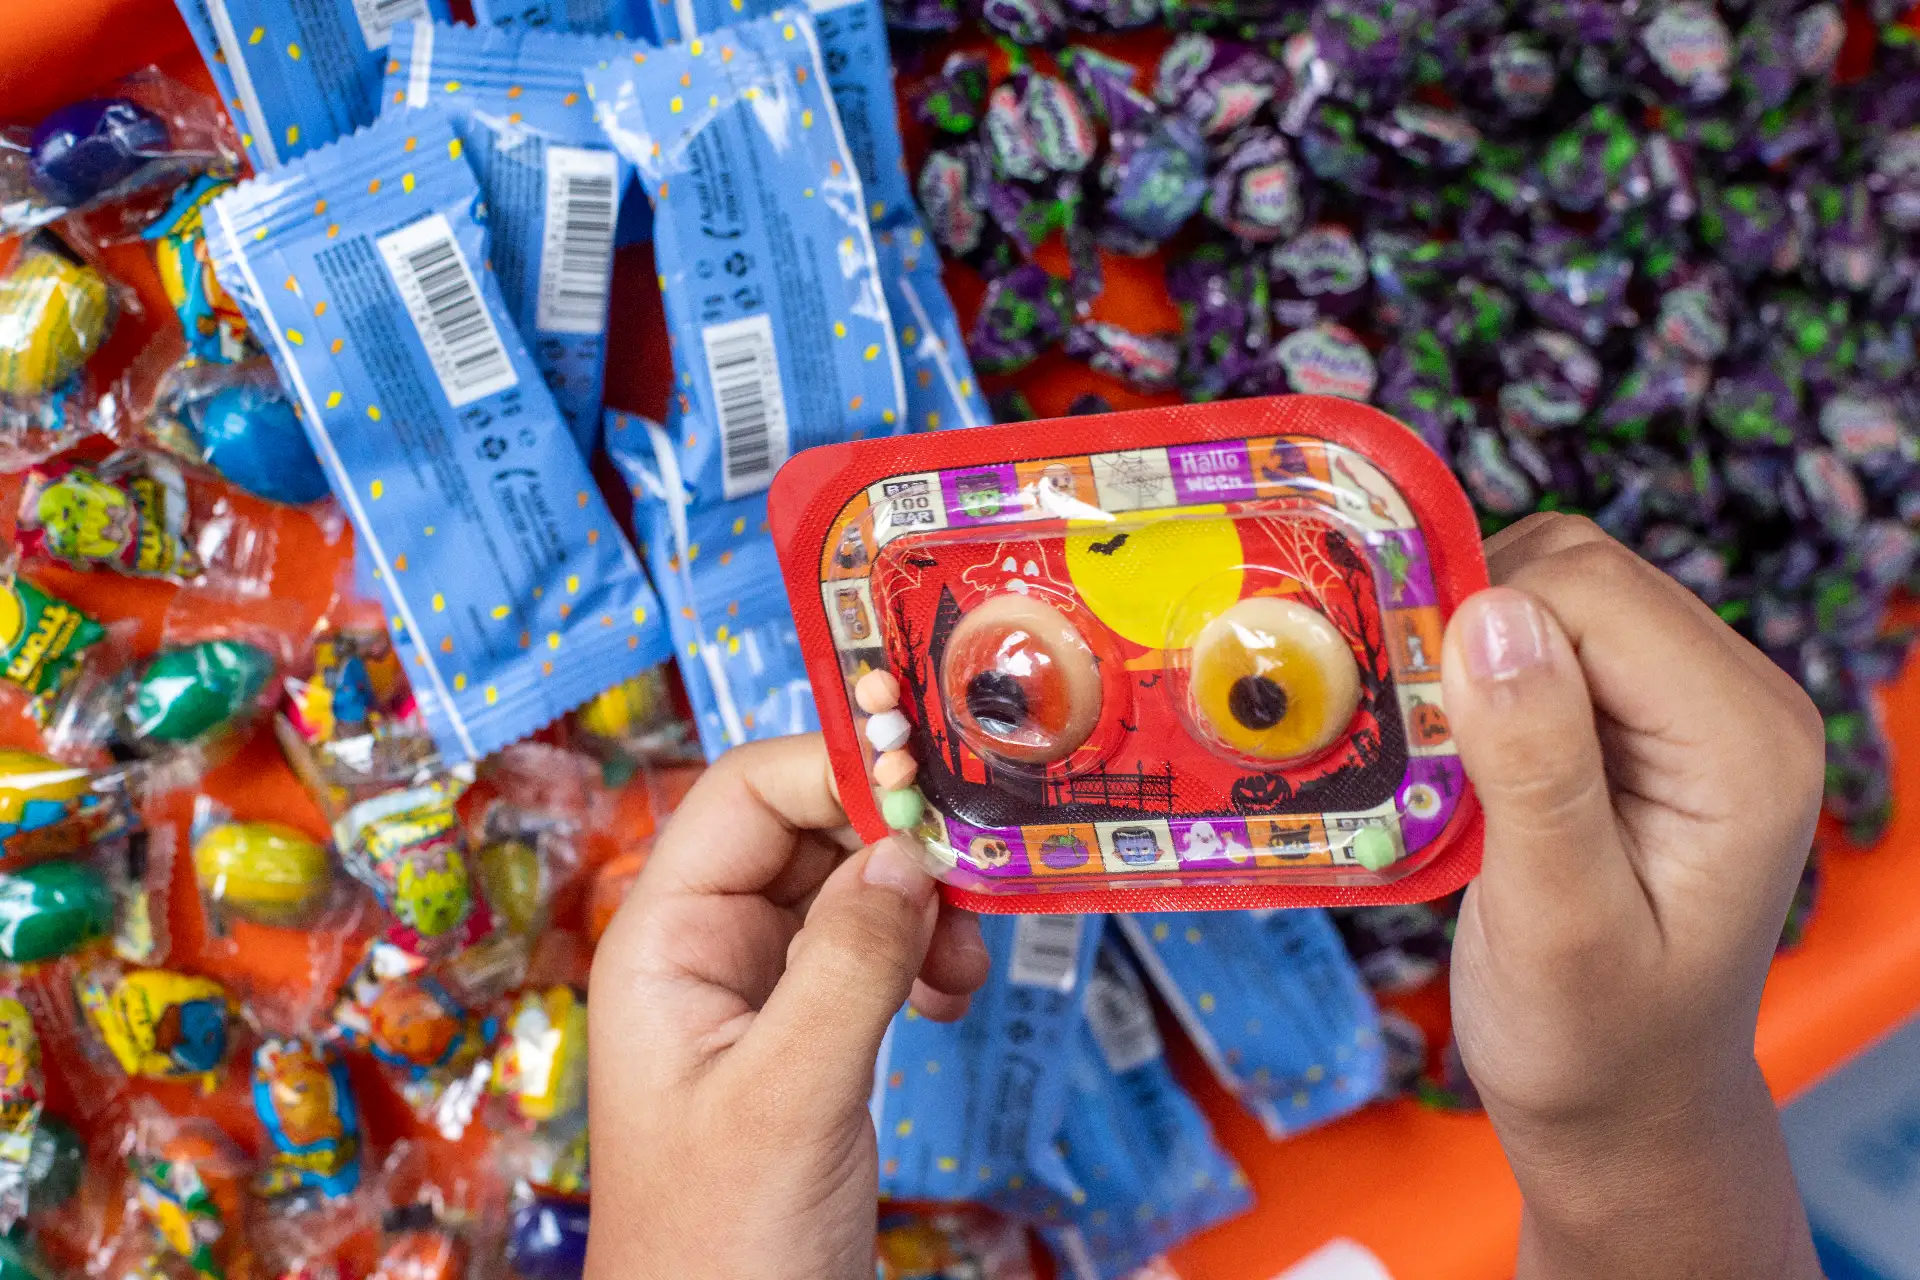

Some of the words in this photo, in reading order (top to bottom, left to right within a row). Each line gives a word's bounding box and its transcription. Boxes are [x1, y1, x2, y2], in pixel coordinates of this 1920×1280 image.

[1181, 450, 1239, 474] Hallo
[1185, 475, 1242, 491] ween
[892, 497, 929, 511] 100
[892, 510, 933, 525] BAR
